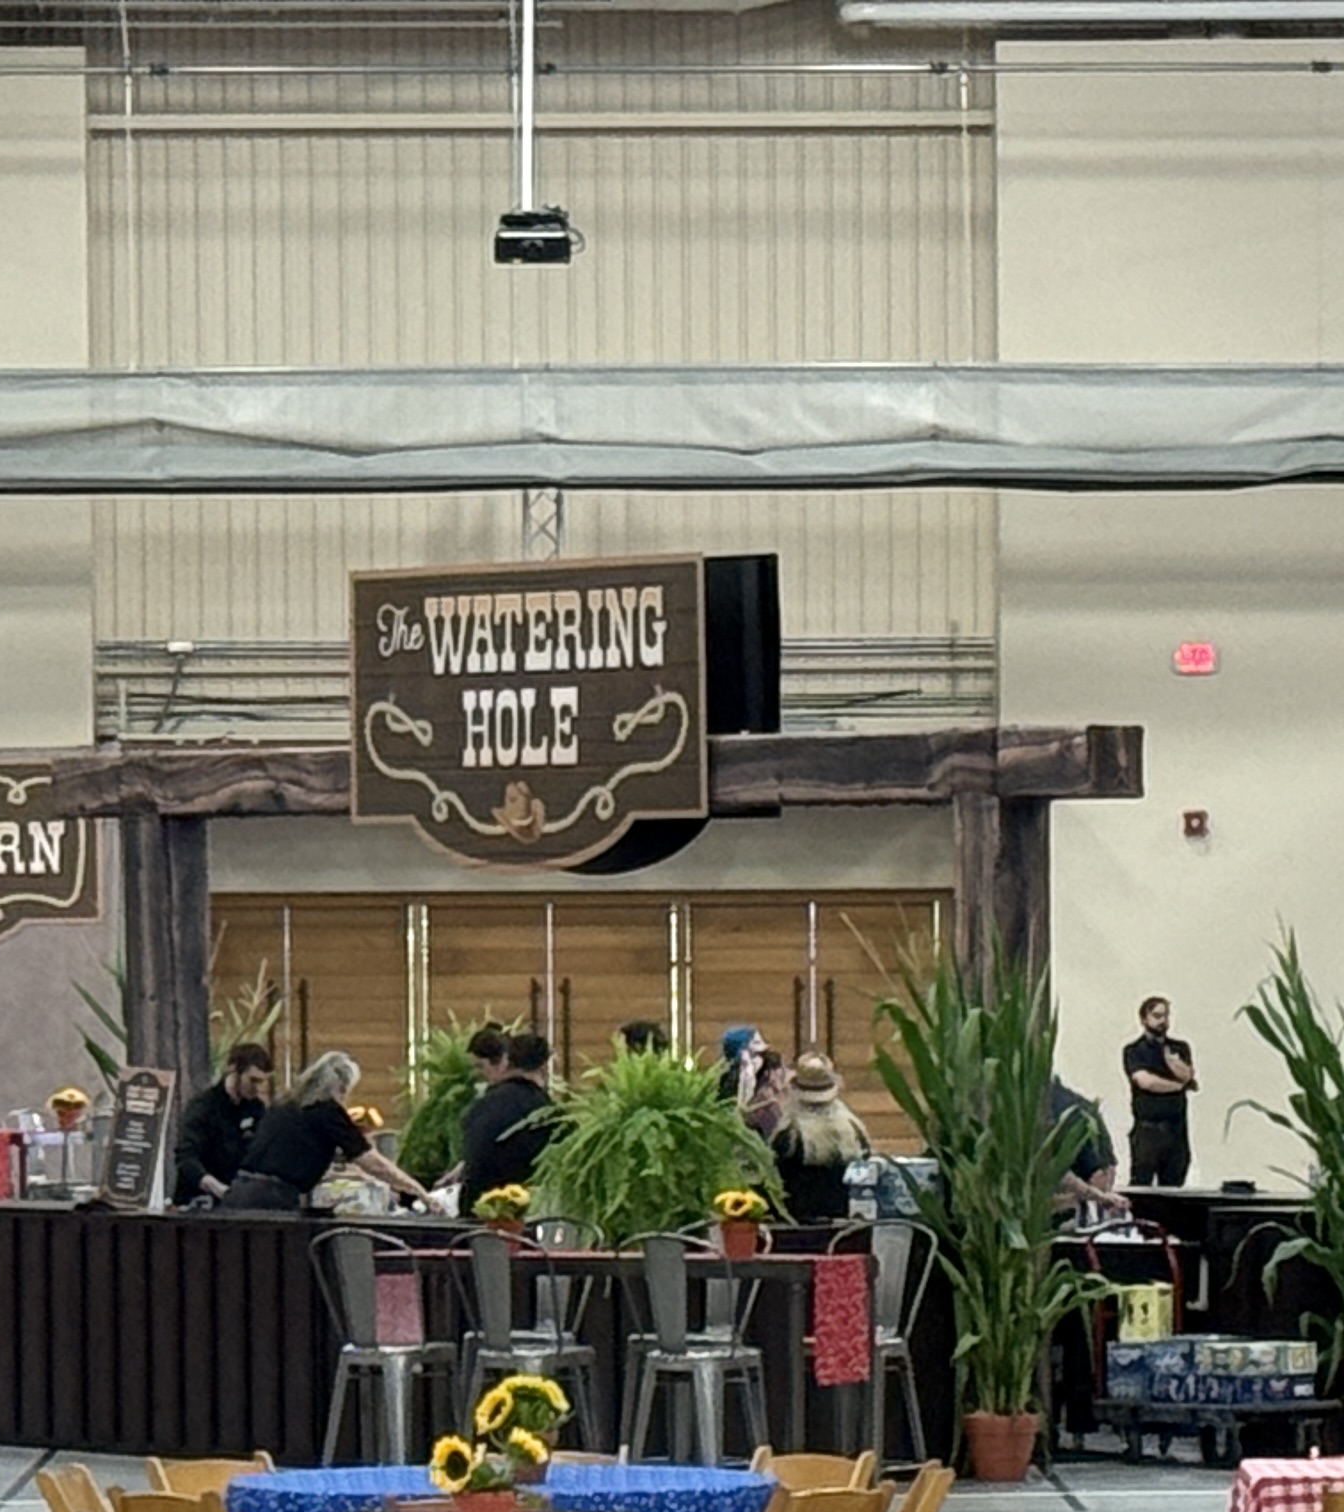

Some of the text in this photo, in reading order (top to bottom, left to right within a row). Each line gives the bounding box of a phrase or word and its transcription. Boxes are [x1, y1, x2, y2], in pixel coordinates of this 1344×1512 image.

[377, 586, 667, 675] The WATERING
[462, 686, 579, 767] HOLE
